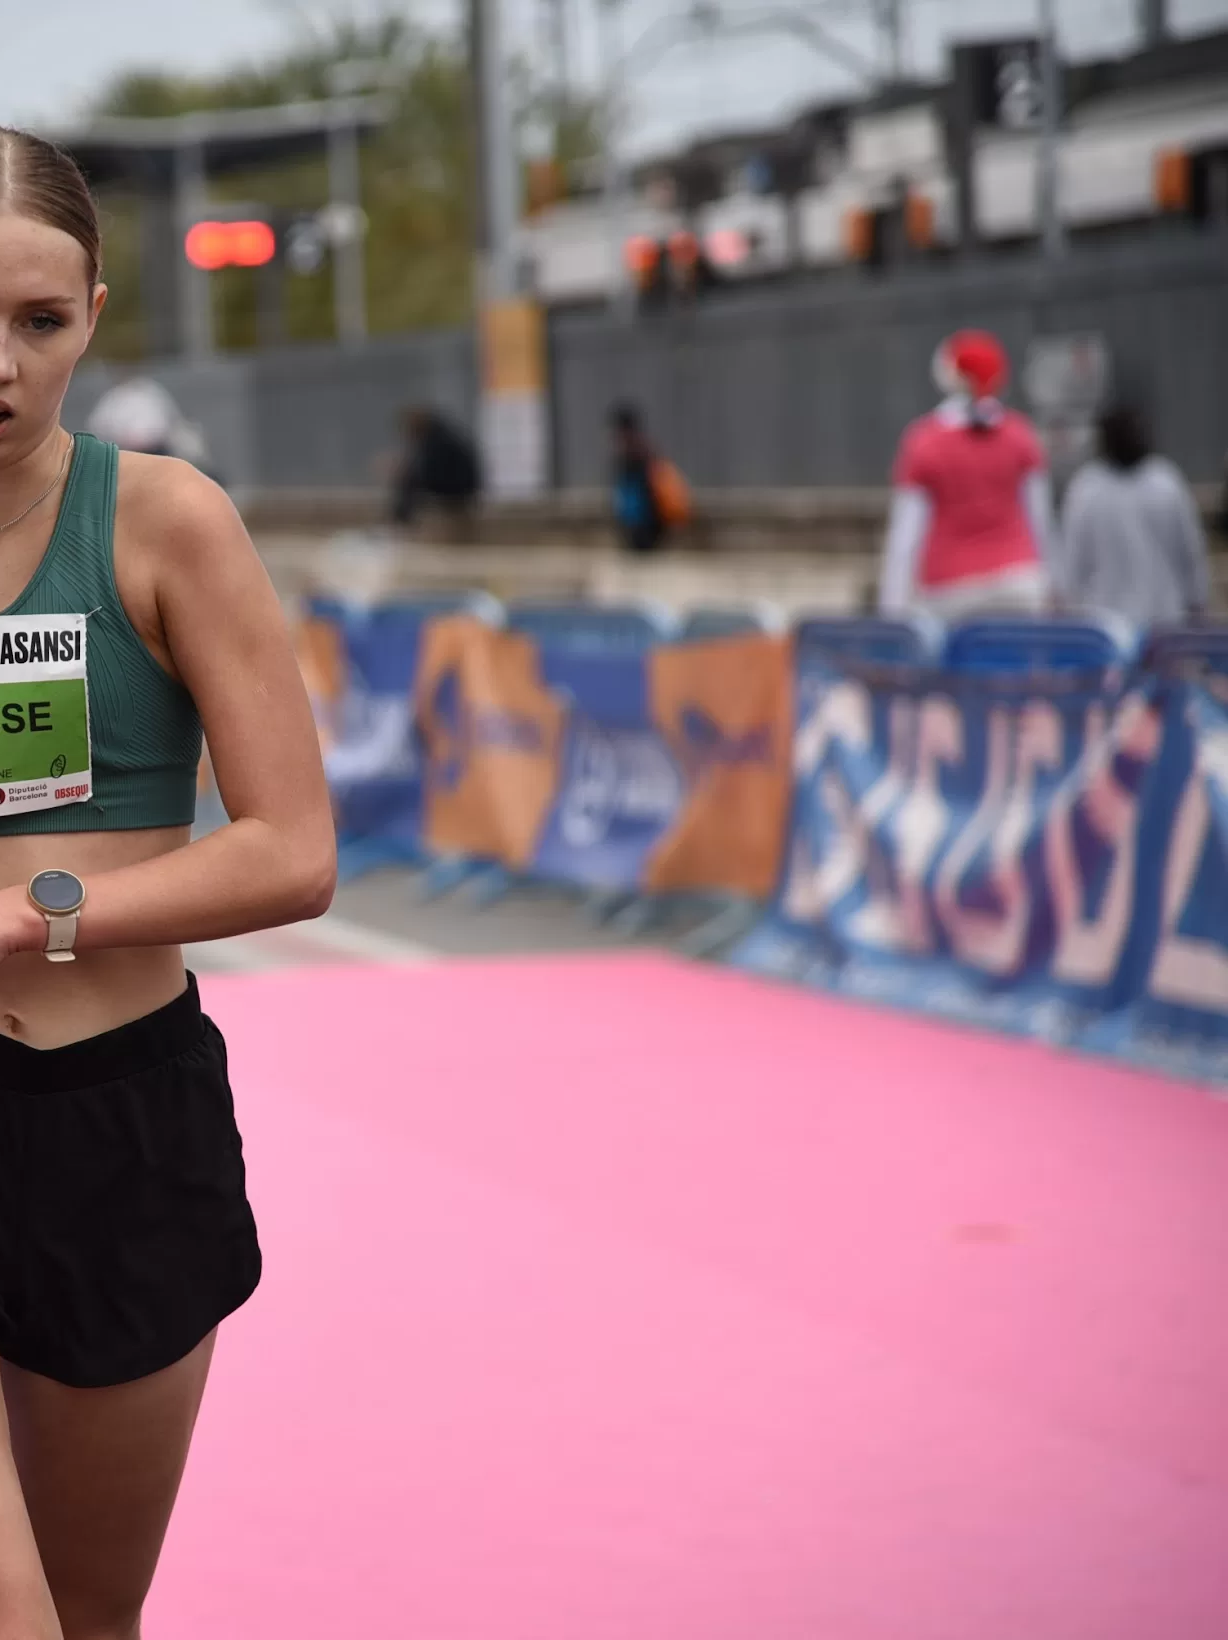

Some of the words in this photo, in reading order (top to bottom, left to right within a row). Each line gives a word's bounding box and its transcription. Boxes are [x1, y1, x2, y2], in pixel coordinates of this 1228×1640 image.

[8, 784, 48, 795] Diputació
[54, 783, 89, 800] OBSEQUI
[9, 792, 48, 802] Barcelona
